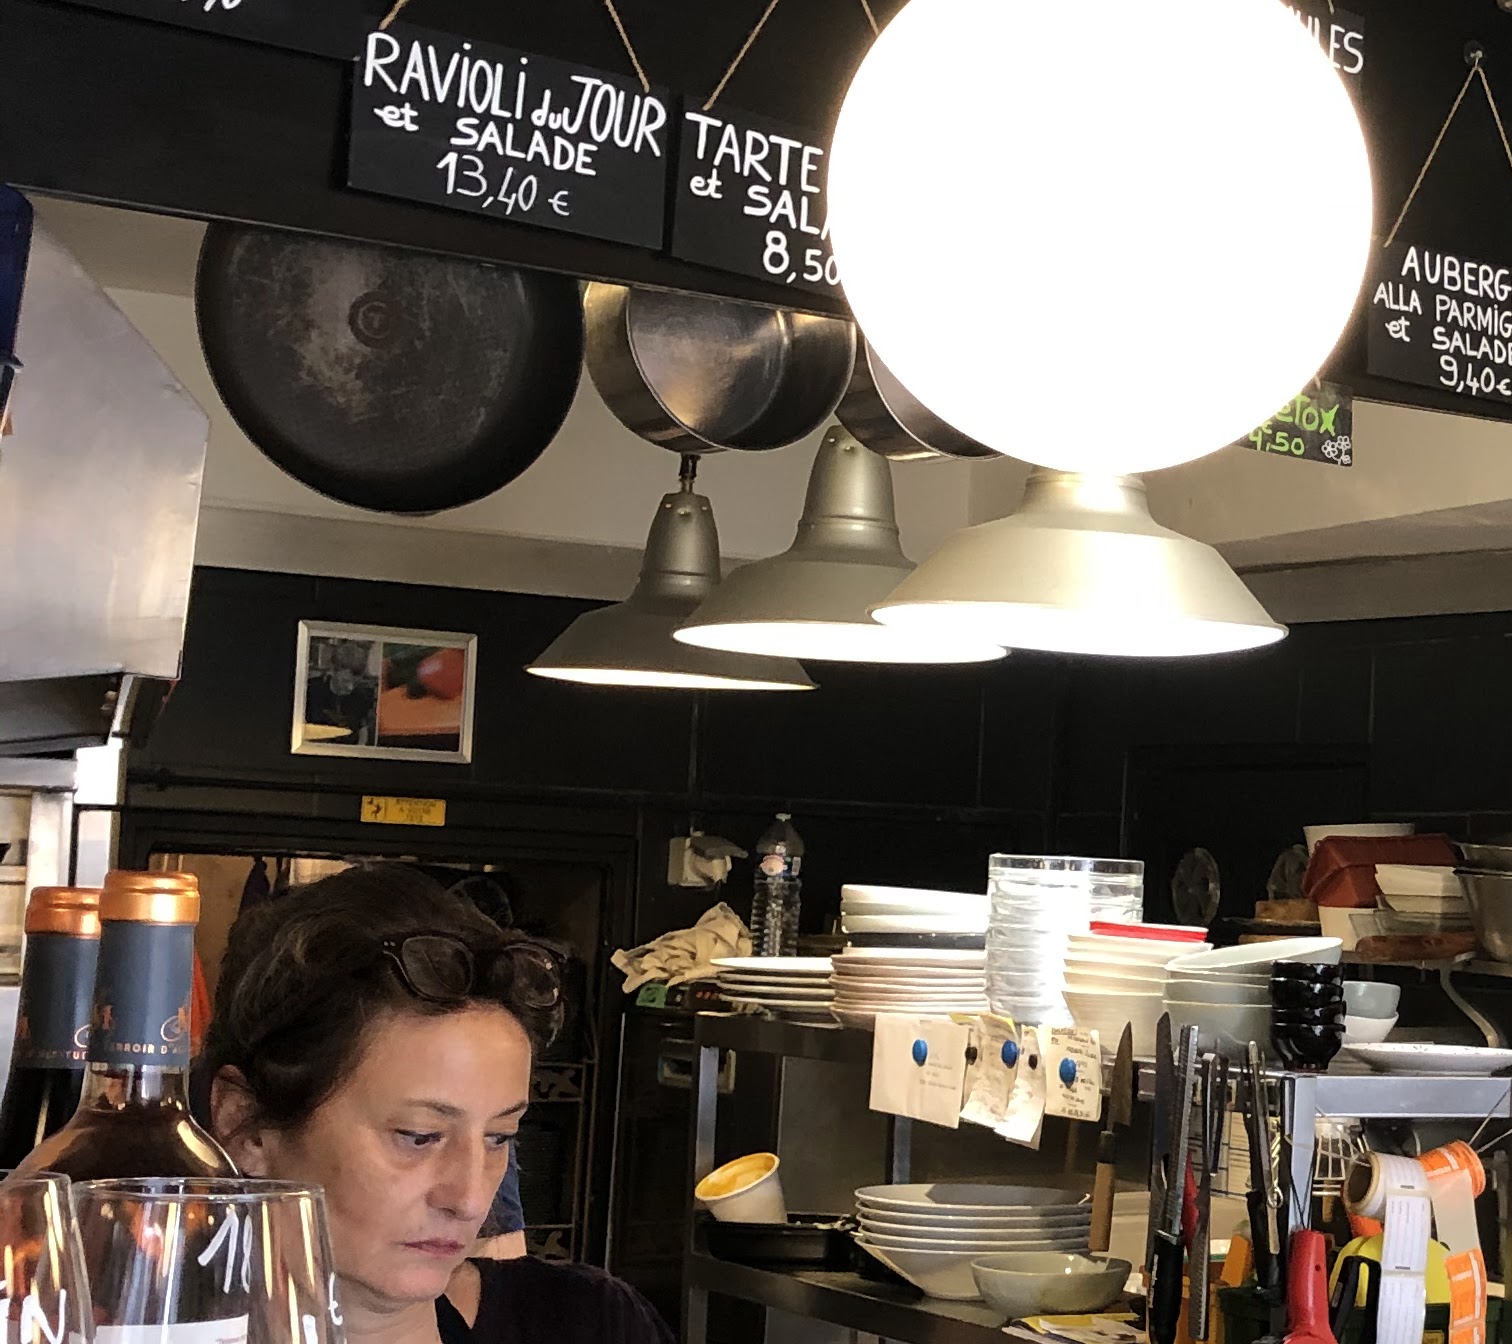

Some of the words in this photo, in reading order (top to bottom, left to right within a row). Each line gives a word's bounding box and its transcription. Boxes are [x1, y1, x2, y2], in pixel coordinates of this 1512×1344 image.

[373, 105, 419, 133] et
[450, 117, 597, 177] SALADE
[561, 76, 666, 157] JOUR
[685, 111, 824, 194] TARTE
[689, 168, 722, 201] et
[1373, 281, 1422, 316] ALLA
[1384, 316, 1411, 344] et
